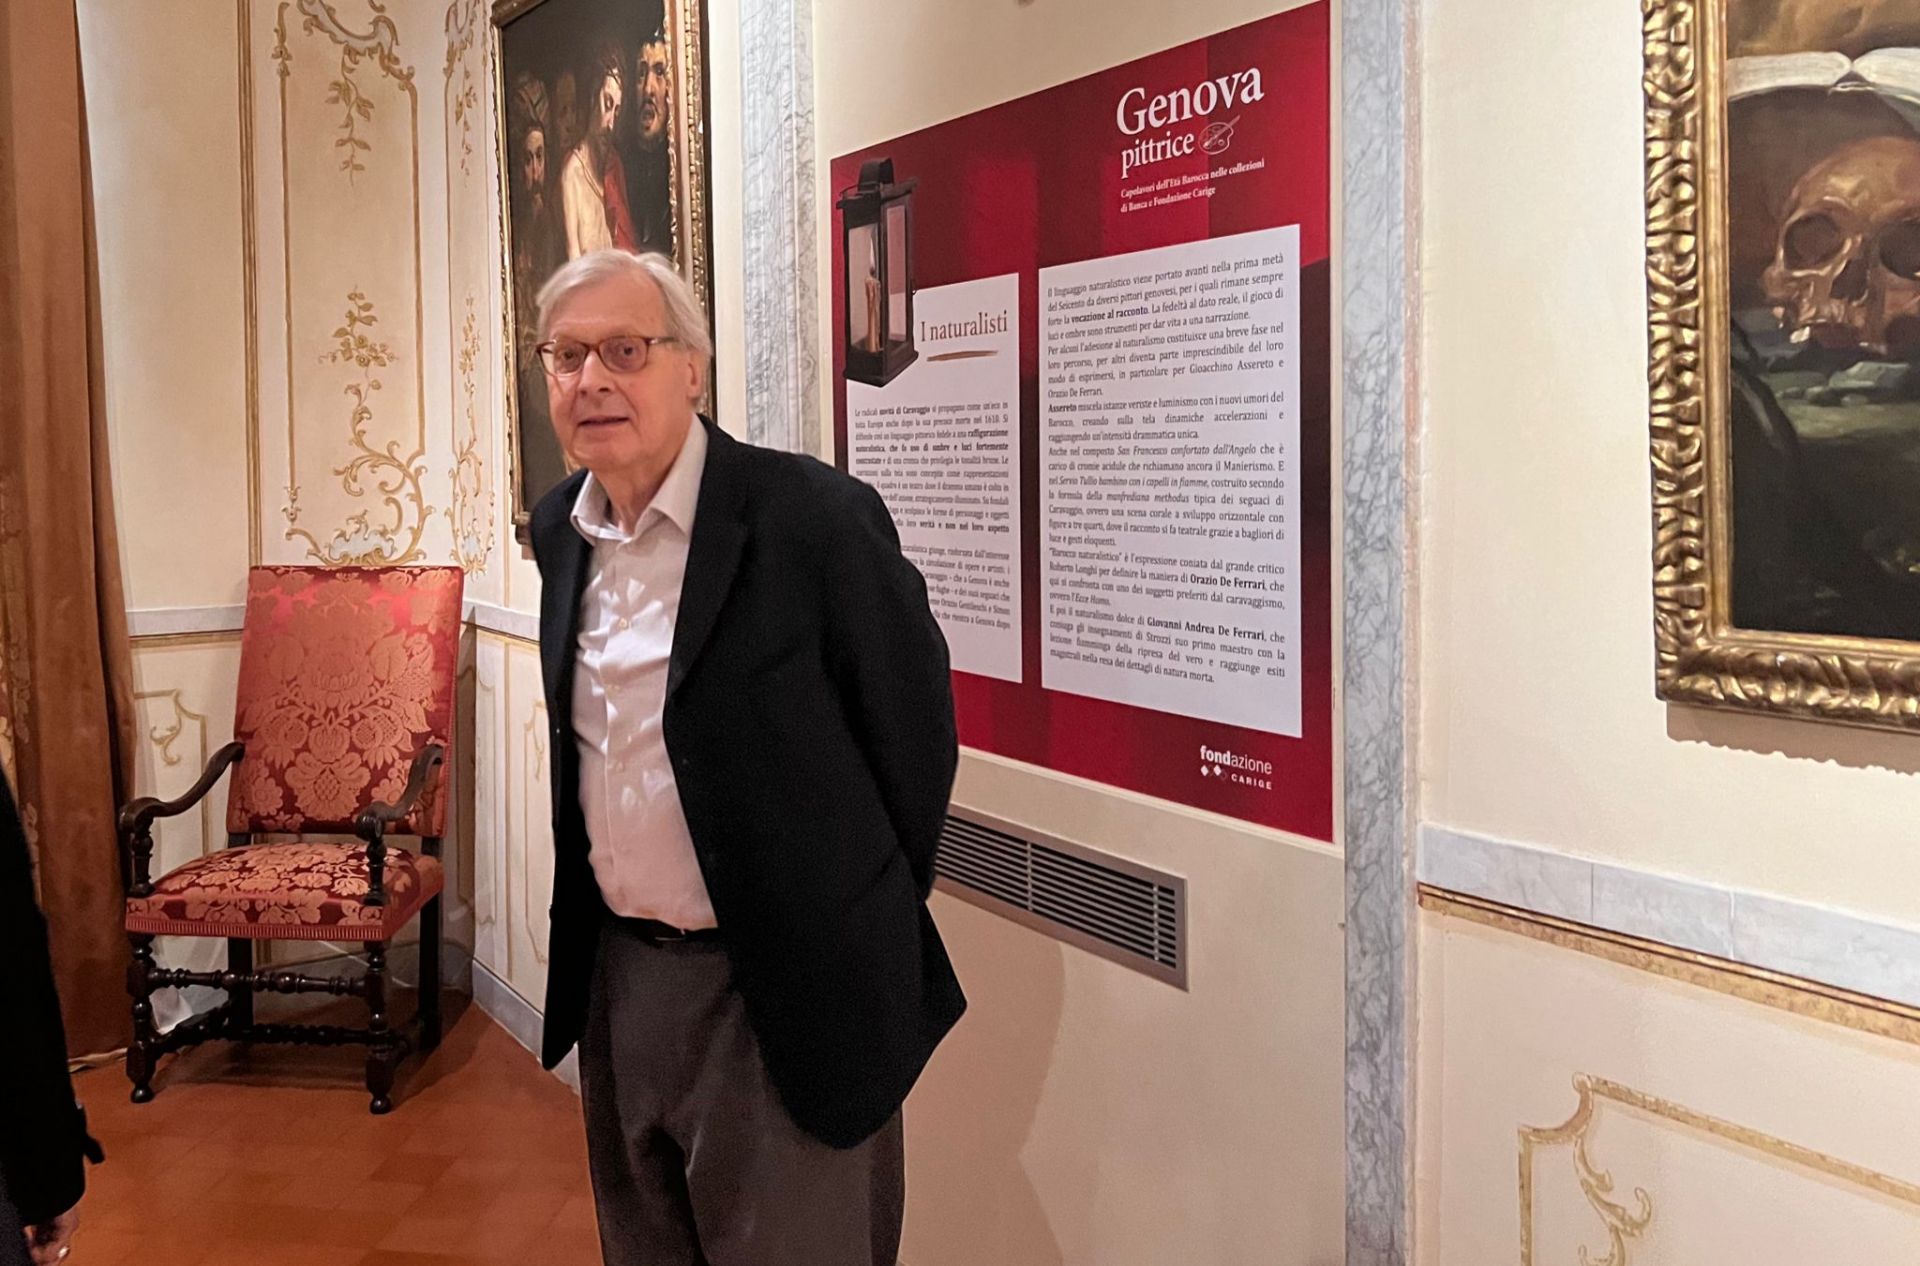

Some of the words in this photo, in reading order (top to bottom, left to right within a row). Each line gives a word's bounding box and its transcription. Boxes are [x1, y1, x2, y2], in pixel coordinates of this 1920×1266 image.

[1116, 67, 1264, 136] Genova
[1121, 131, 1194, 179] pittrice
[1121, 182, 1154, 199] Capolavori
[1156, 177, 1180, 190] dell'Età
[1182, 170, 1209, 185] Barocca
[1210, 167, 1227, 178] nelle
[1229, 158, 1264, 174] collezioni
[1120, 203, 1127, 212] di
[1129, 200, 1147, 211] Banca
[1154, 192, 1192, 206] Fondazione
[1192, 186, 1216, 197] Carige
[1155, 269, 1182, 284] portato
[1184, 264, 1208, 277] avanti
[1211, 261, 1230, 274] nella
[1234, 258, 1258, 273] prima
[1262, 253, 1283, 266] metà
[1179, 286, 1192, 297] per
[1198, 279, 1218, 294] quali
[1220, 278, 1249, 289] rimane
[1251, 273, 1283, 285] sempre
[1151, 303, 1160, 313] La
[1162, 299, 1187, 312] fedeltà
[1189, 298, 1196, 309] al
[1198, 296, 1215, 308] dato
[1218, 293, 1239, 306] reale,
[1242, 292, 1247, 303] il
[1250, 290, 1272, 304] gioco
[1275, 287, 1283, 299] di
[921, 320, 926, 342] I
[930, 310, 1008, 341] naturalisti
[1139, 322, 1151, 333] per
[1167, 317, 1181, 327] vita
[1189, 317, 1203, 325] una
[1205, 310, 1250, 323] narrazione.
[1166, 331, 1206, 343] costituisce
[1208, 331, 1223, 339] una
[1225, 327, 1249, 338] breve
[1251, 325, 1268, 335] fase
[1270, 322, 1283, 333] nel
[1182, 343, 1244, 360] imprescindibile
[1248, 341, 1261, 352] del
[1266, 340, 1283, 351] loro
[1172, 367, 1185, 377] per
[1189, 361, 1232, 373] Gioacchino
[1237, 357, 1273, 370] Assereto
[1199, 397, 1213, 405] con
[1219, 393, 1241, 404] nuovi
[1243, 391, 1268, 403] umori
[1270, 391, 1283, 402] del
[1142, 413, 1155, 423] tela
[1164, 411, 1203, 422] dinamiche
[1214, 408, 1267, 421] accelerazioni
[1177, 428, 1199, 438] unica.
[1170, 444, 1209, 456] confortato
[1212, 443, 1256, 456] dall'Angelo
[1260, 442, 1274, 453] che
[1215, 460, 1220, 470] il
[1224, 460, 1274, 470] Manierismo.
[1171, 476, 1177, 486] in
[1211, 476, 1247, 487] costruito
[1249, 477, 1284, 487] secondo
[1194, 492, 1215, 505] tipica
[1221, 493, 1233, 503] dei
[1239, 493, 1269, 506] seguaci
[1275, 494, 1283, 504] di
[1183, 508, 1215, 521] sviluppo
[1219, 509, 1264, 521] orizzontale
[1268, 514, 1284, 522] con
[1169, 523, 1176, 533] fa
[1178, 524, 1207, 535] teatrale
[1209, 526, 1233, 538] grazie
[1241, 526, 1273, 540] bagliori
[1275, 528, 1284, 539] di
[1179, 556, 1208, 568] coniata
[1210, 558, 1223, 569] dal
[1225, 560, 1255, 572] grande
[1256, 561, 1284, 573] critico
[1148, 570, 1178, 581] maniera
[1180, 572, 1187, 582] di
[1190, 572, 1217, 585] Orazio
[1219, 575, 1231, 586] De
[1233, 576, 1267, 592] Ferrari,
[1269, 579, 1284, 590] che
[1176, 588, 1207, 600] preferiti
[1210, 590, 1223, 602] dal
[1225, 595, 1285, 610] caravaggismo,
[1137, 614, 1144, 625] di
[1147, 616, 1181, 629] Giovanni
[1184, 620, 1214, 633] Andrea
[1218, 624, 1229, 635] De
[1233, 625, 1267, 643] Ferrari,
[1269, 630, 1285, 642] che
[1146, 631, 1171, 644] Strozzi
[1174, 638, 1188, 646] suo
[1192, 638, 1215, 650] primo
[1220, 643, 1253, 655] maestro
[1257, 648, 1272, 658] con
[1277, 648, 1285, 659] la
[1137, 646, 1163, 659] ripresa
[1168, 650, 1180, 661] del
[1185, 655, 1203, 664] vero
[1219, 659, 1260, 675] raggiunge
[1267, 665, 1285, 676] esiti
[1163, 666, 1187, 678] natura
[1189, 671, 1214, 682] morta.
[1200, 745, 1272, 774] fondazione
[1231, 774, 1272, 790] CARIGE
